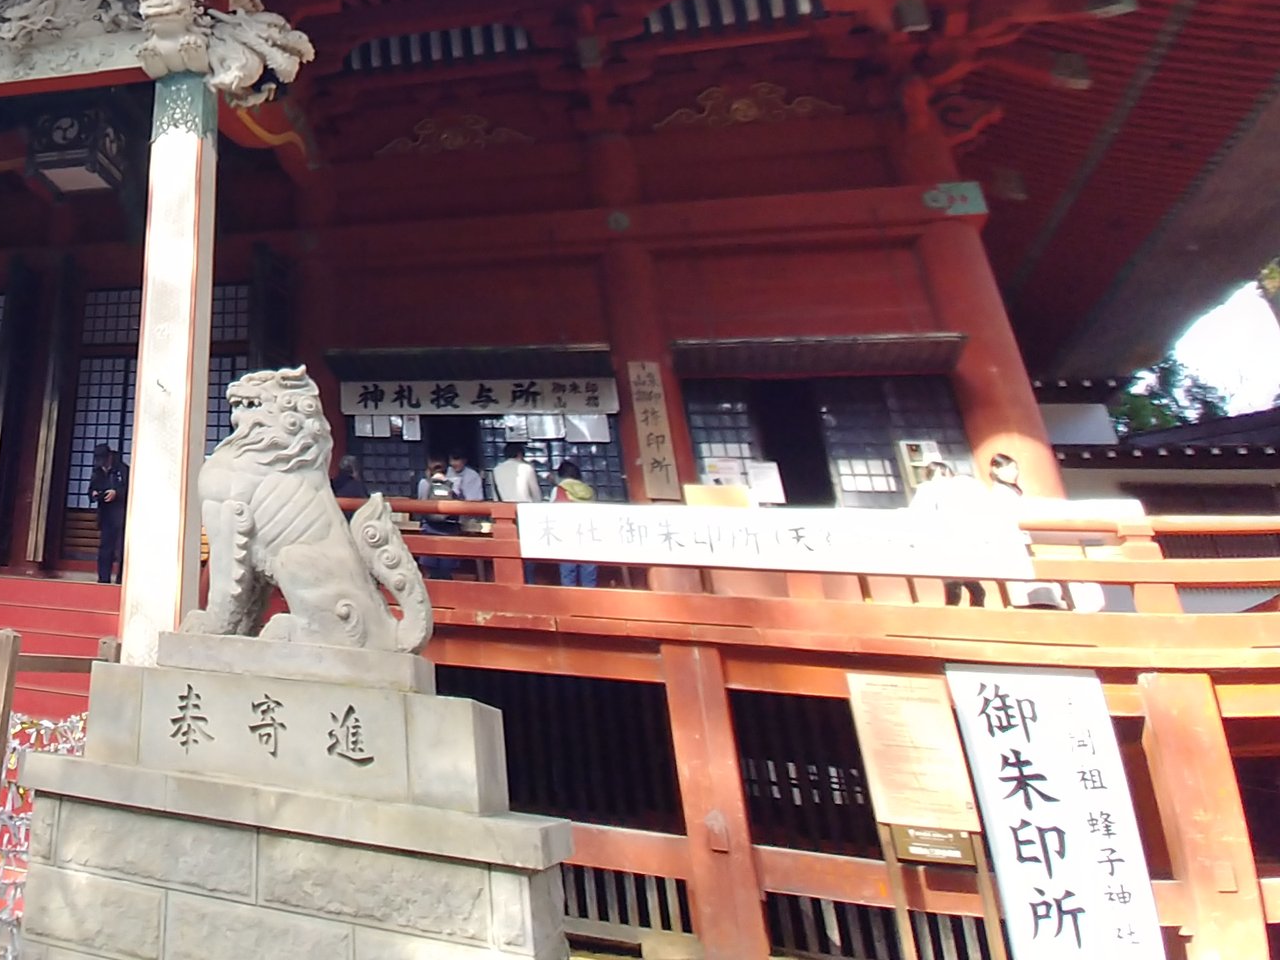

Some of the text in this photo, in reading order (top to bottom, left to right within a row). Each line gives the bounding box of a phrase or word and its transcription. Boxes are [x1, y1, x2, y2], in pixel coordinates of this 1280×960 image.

[357, 381, 541, 410] 神札授与所
[169, 683, 375, 767] 奉寄進
[977, 682, 1087, 950] 御朱印所
